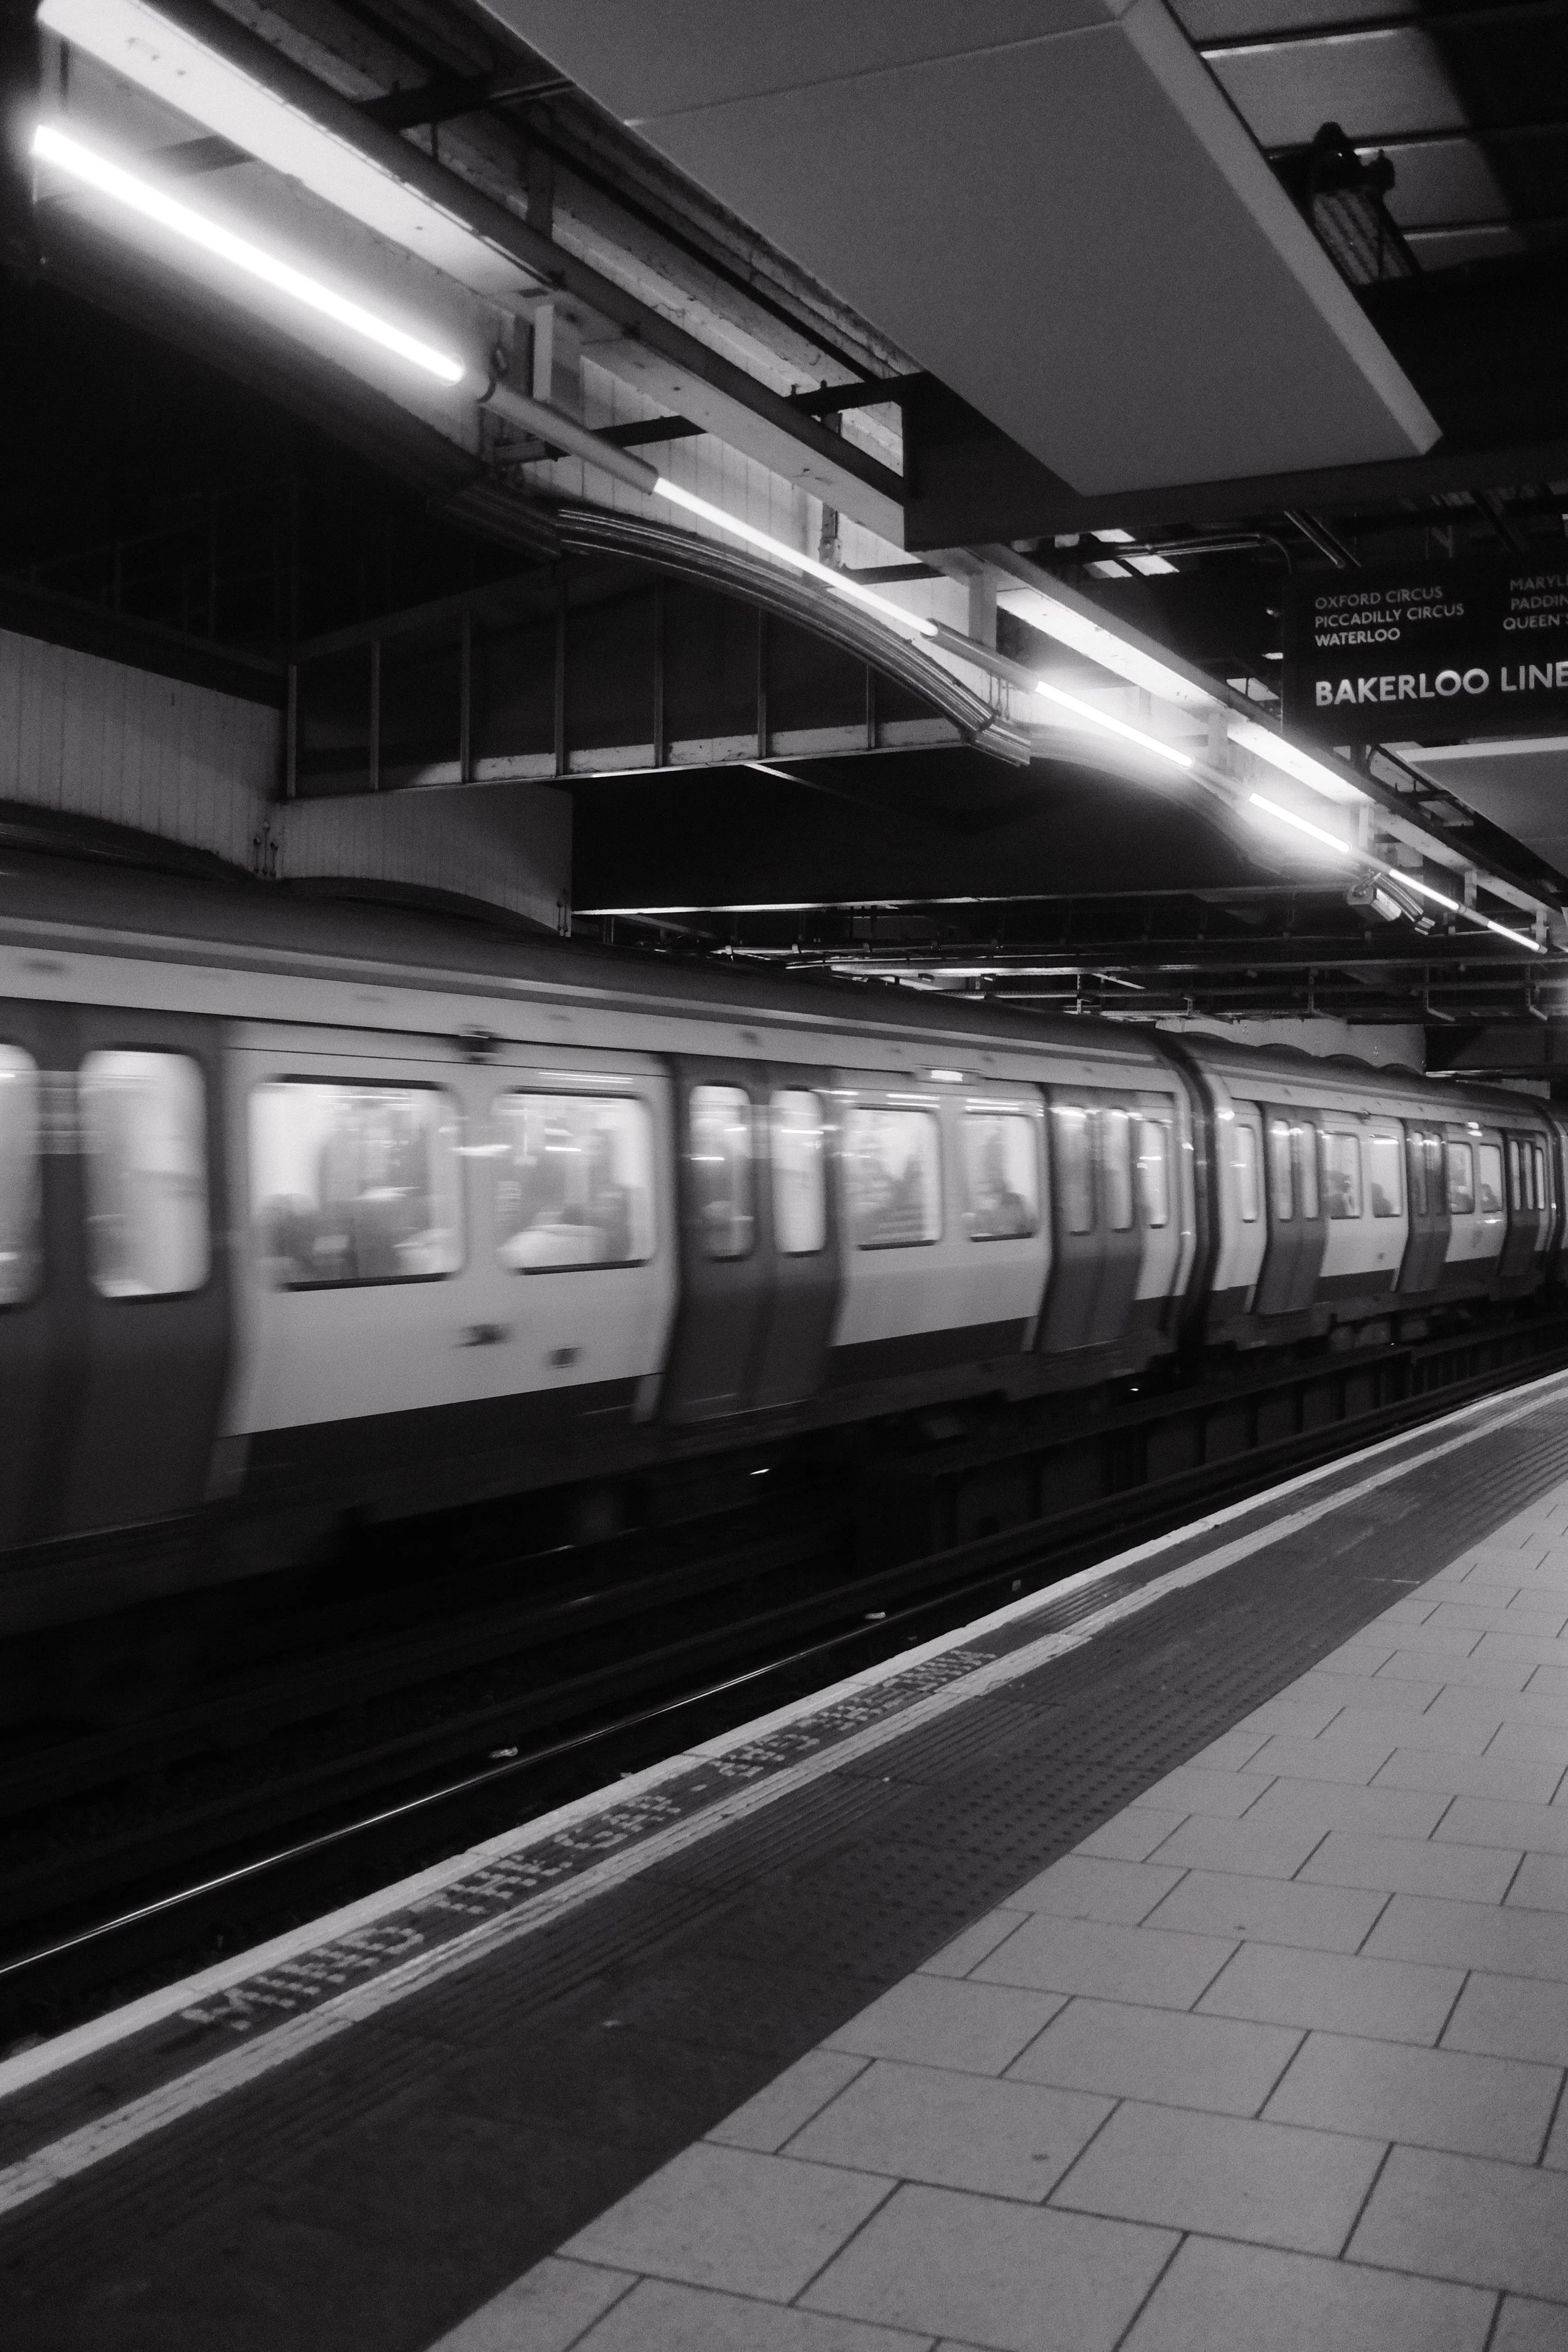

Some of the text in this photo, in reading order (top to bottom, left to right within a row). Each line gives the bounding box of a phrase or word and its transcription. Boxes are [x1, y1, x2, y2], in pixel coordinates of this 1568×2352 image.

[1510, 573, 1568, 592] MARYL
[1315, 586, 1443, 610] OXFORD CIRCUS
[1315, 603, 1465, 628] PICCADILLY CIRCUS
[1315, 627, 1401, 647] WATERLOO
[1316, 660, 1568, 706] BAKERLOO LINE
[178, 1926, 425, 2032] MIND
[406, 1854, 574, 1915] THE
